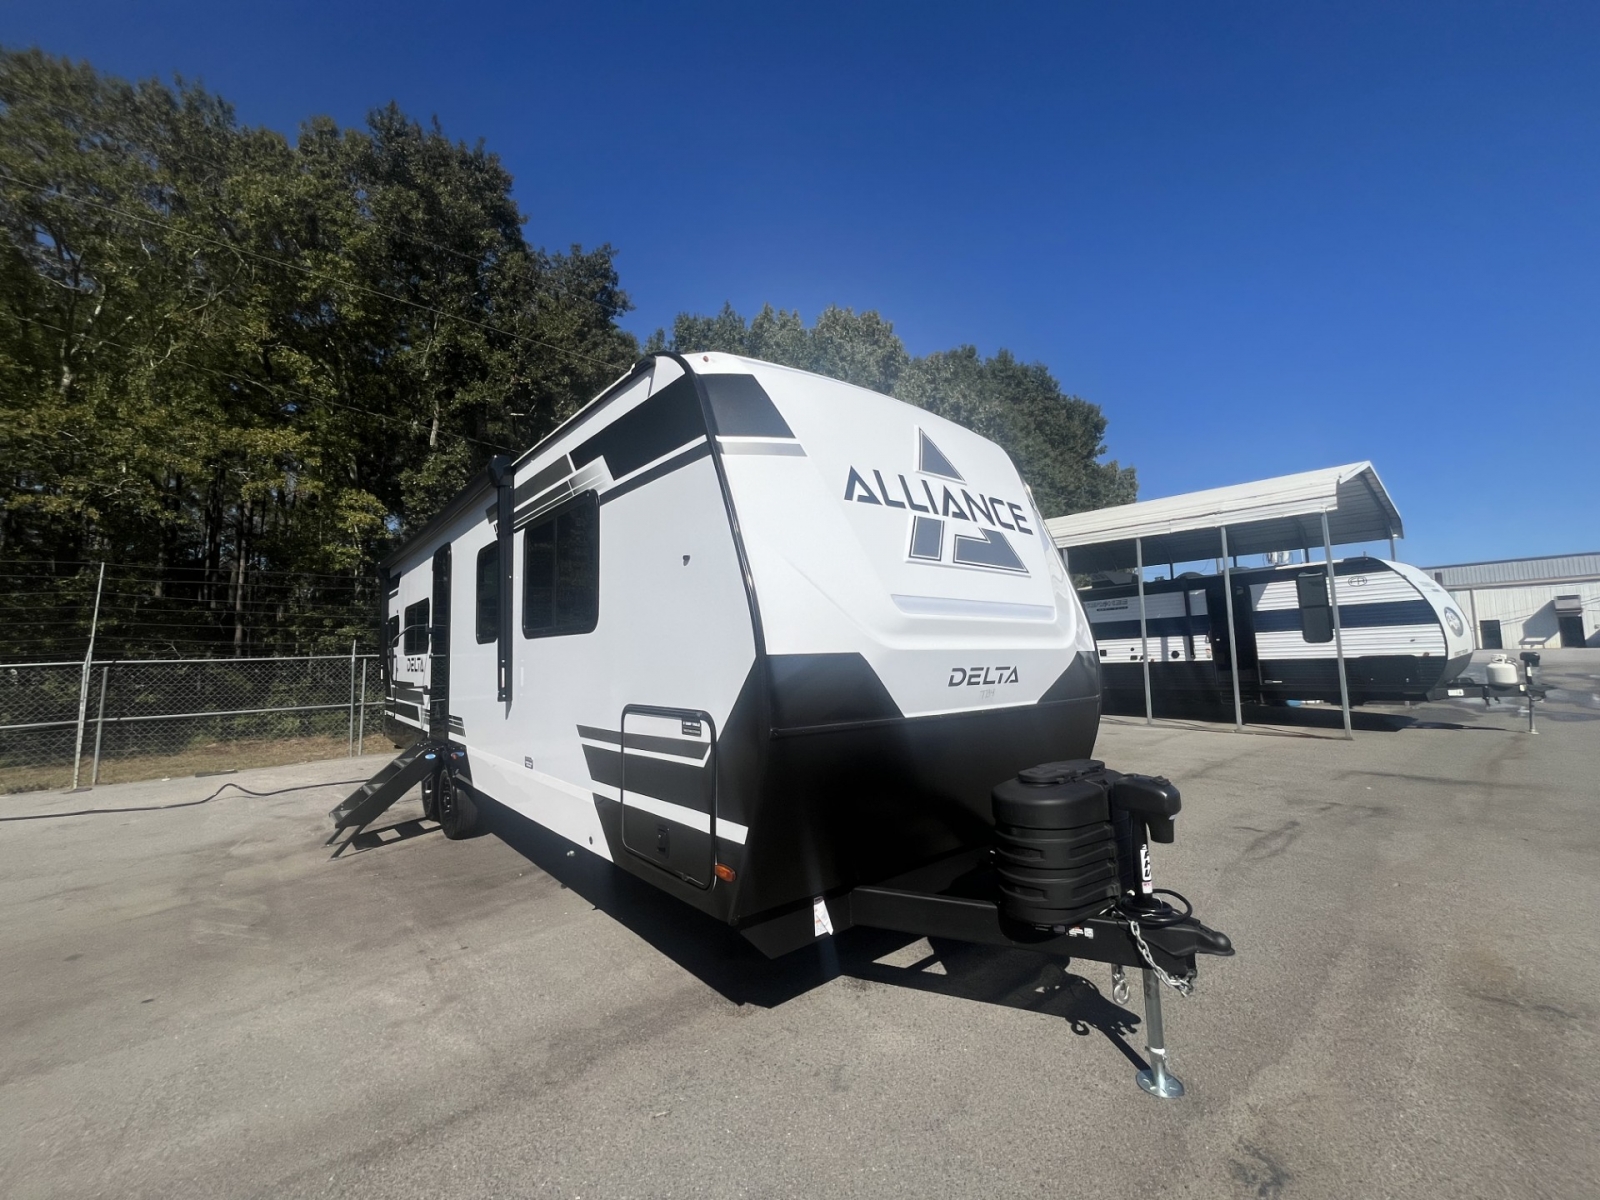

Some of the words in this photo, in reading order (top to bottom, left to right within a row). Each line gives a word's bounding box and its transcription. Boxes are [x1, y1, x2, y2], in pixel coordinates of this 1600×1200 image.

[844, 464, 1034, 536] ALLIANCE
[407, 657, 424, 672] DELTA
[947, 665, 1019, 687] DELTA
